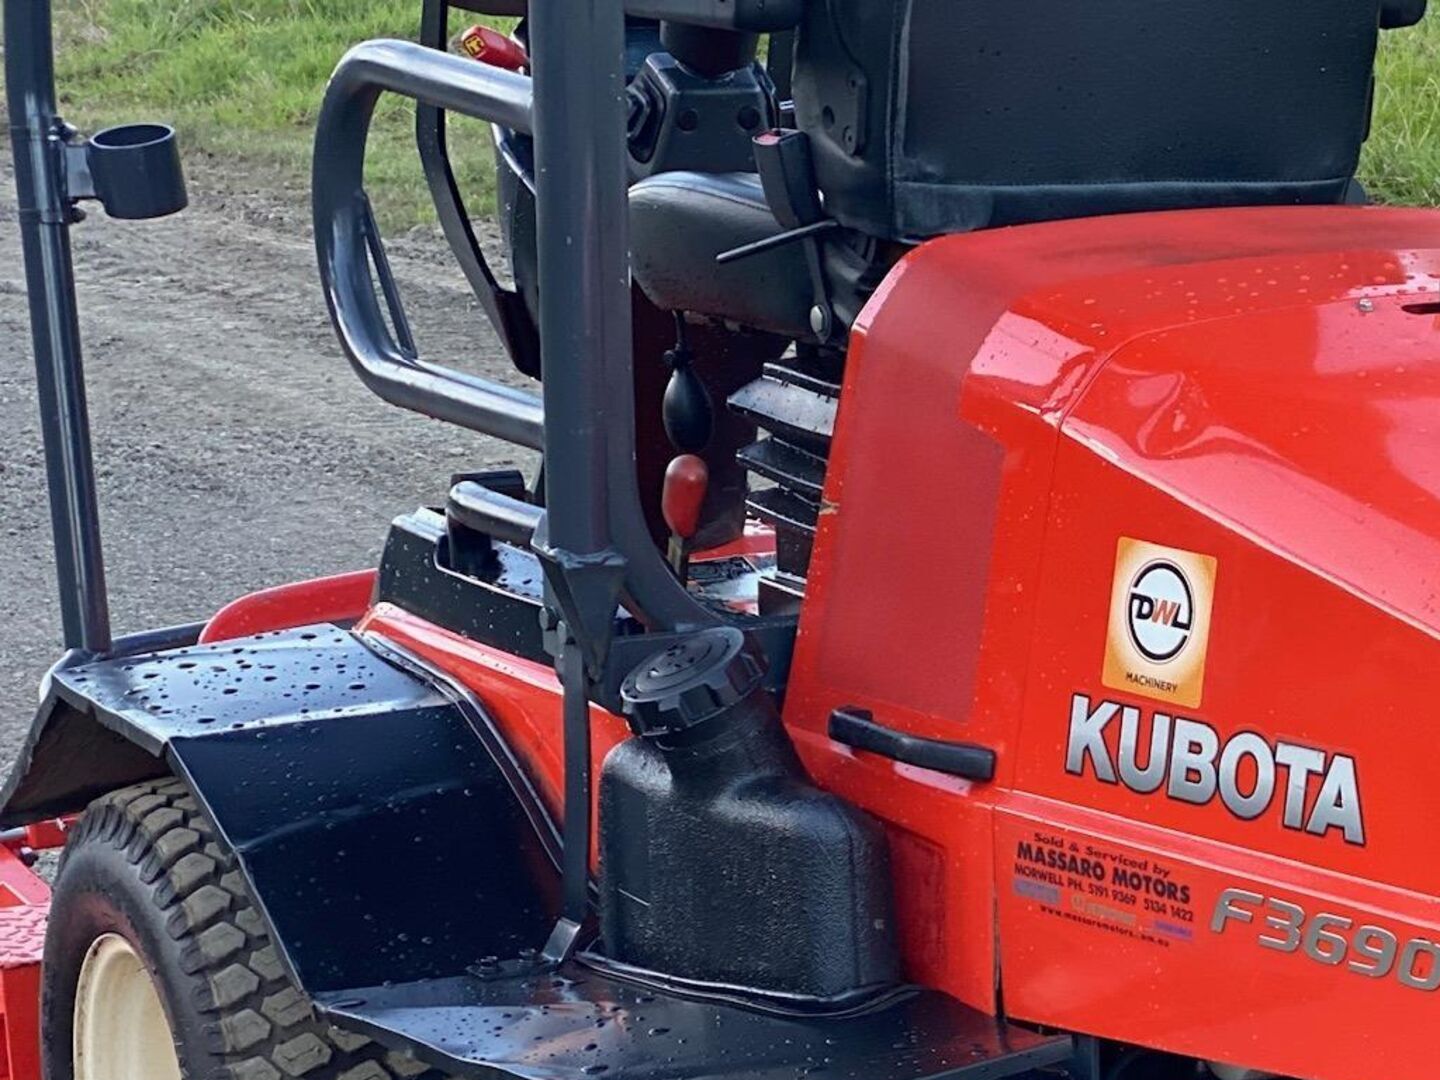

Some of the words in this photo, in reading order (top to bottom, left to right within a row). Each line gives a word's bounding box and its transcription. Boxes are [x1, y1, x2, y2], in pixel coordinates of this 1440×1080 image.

[1129, 592, 1191, 631] DWL
[1126, 671, 1178, 693] MACHINERY
[1065, 693, 1366, 847] KUBOTA
[1014, 863, 1064, 887] MORWELL
[1017, 841, 1106, 881] MASSARO
[1112, 867, 1191, 904] MOTORS
[1034, 832, 1064, 848] Sold
[1069, 842, 1080, 853] &
[1086, 846, 1149, 870] Serviced
[1153, 863, 1171, 879] by
